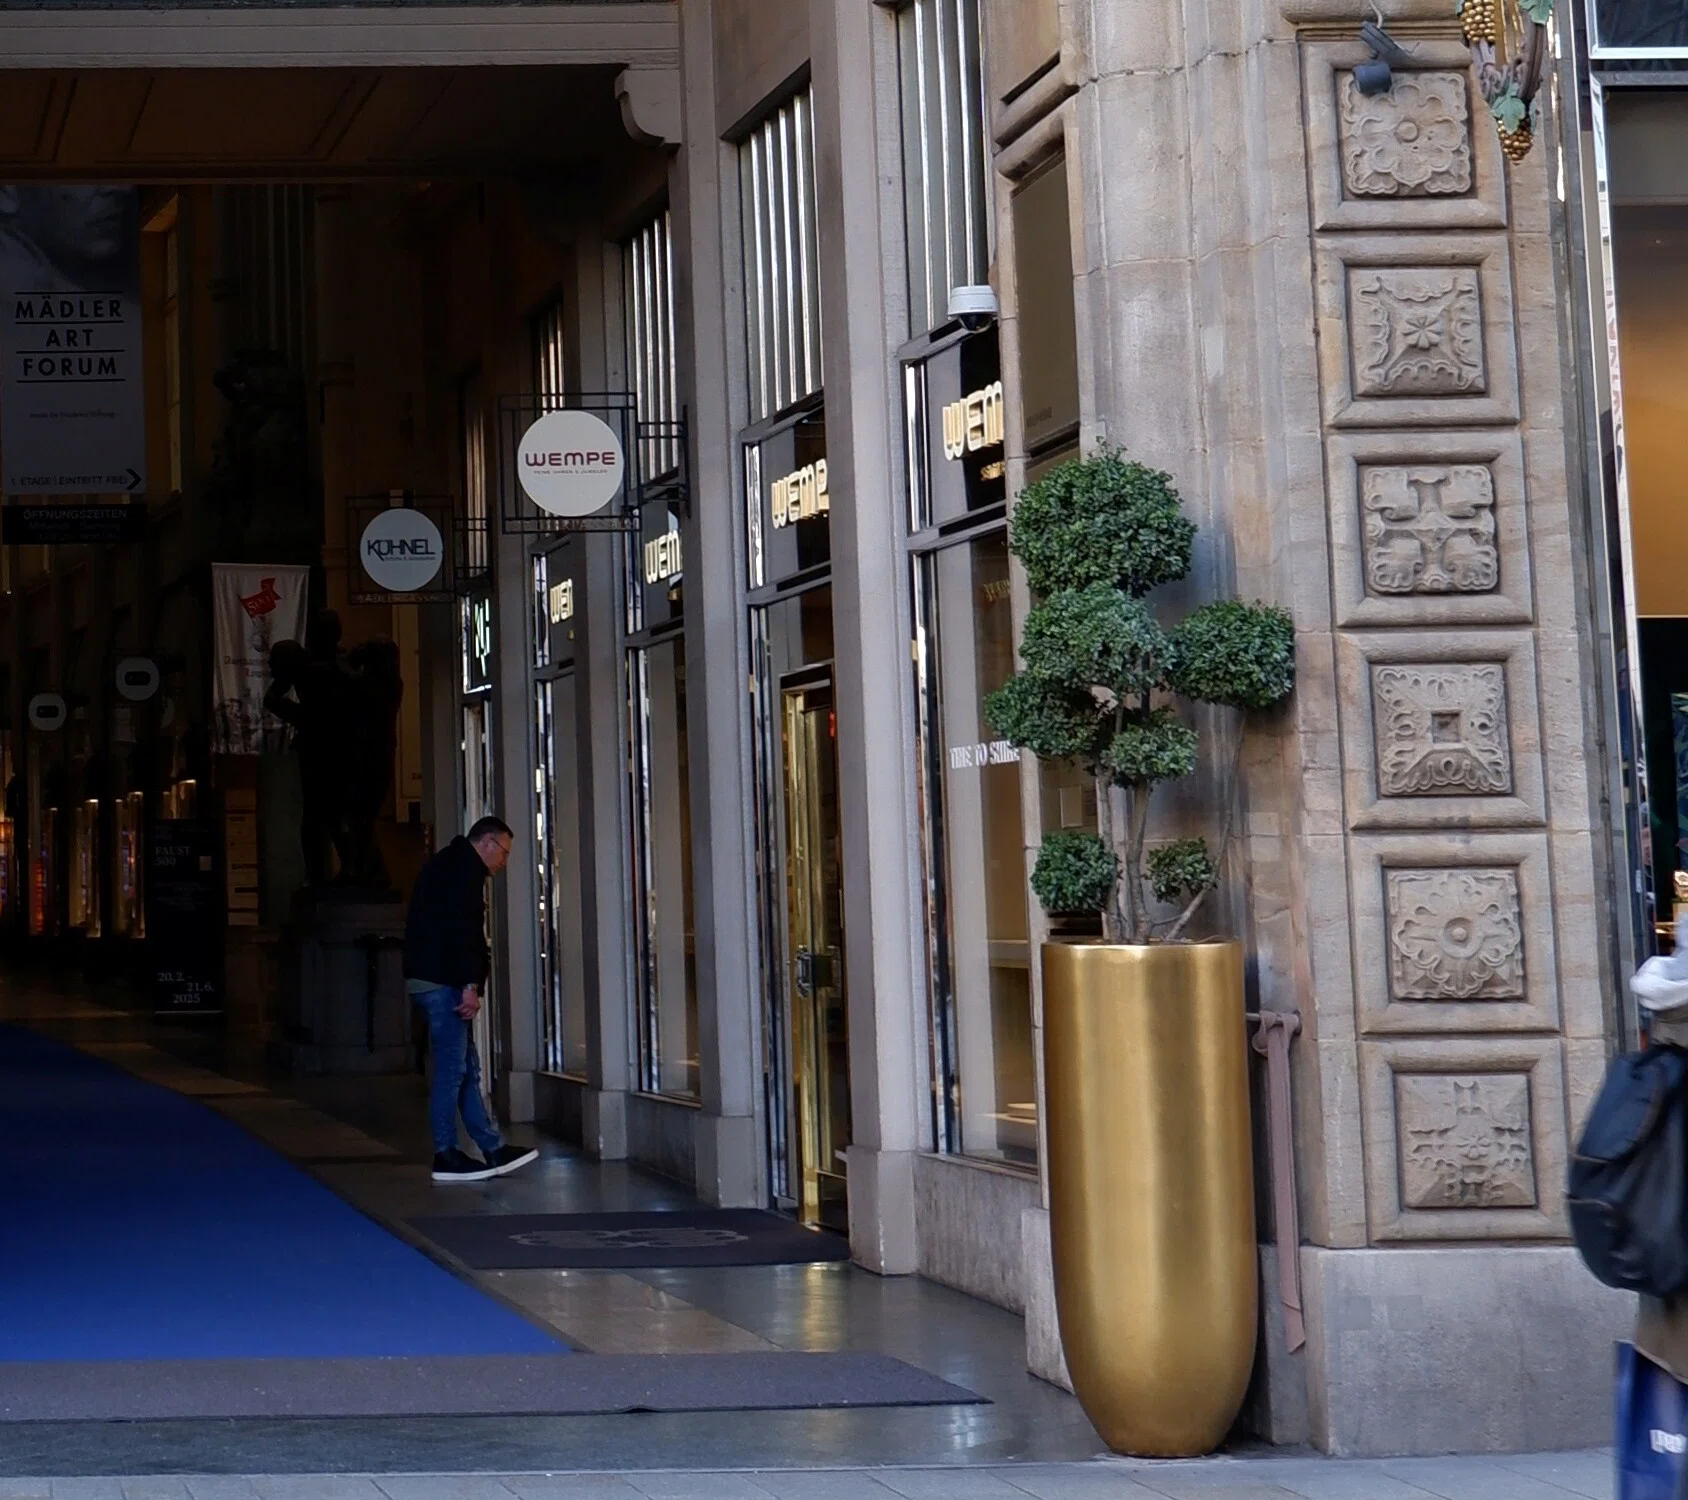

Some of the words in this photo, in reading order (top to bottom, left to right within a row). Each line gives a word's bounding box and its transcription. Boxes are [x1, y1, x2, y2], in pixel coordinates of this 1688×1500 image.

[15, 296, 122, 319] MÄDLER
[46, 329, 93, 347] ART
[23, 357, 116, 377] FORUM
[525, 452, 616, 467] WEMPE
[59, 475, 103, 486] EINTRITT
